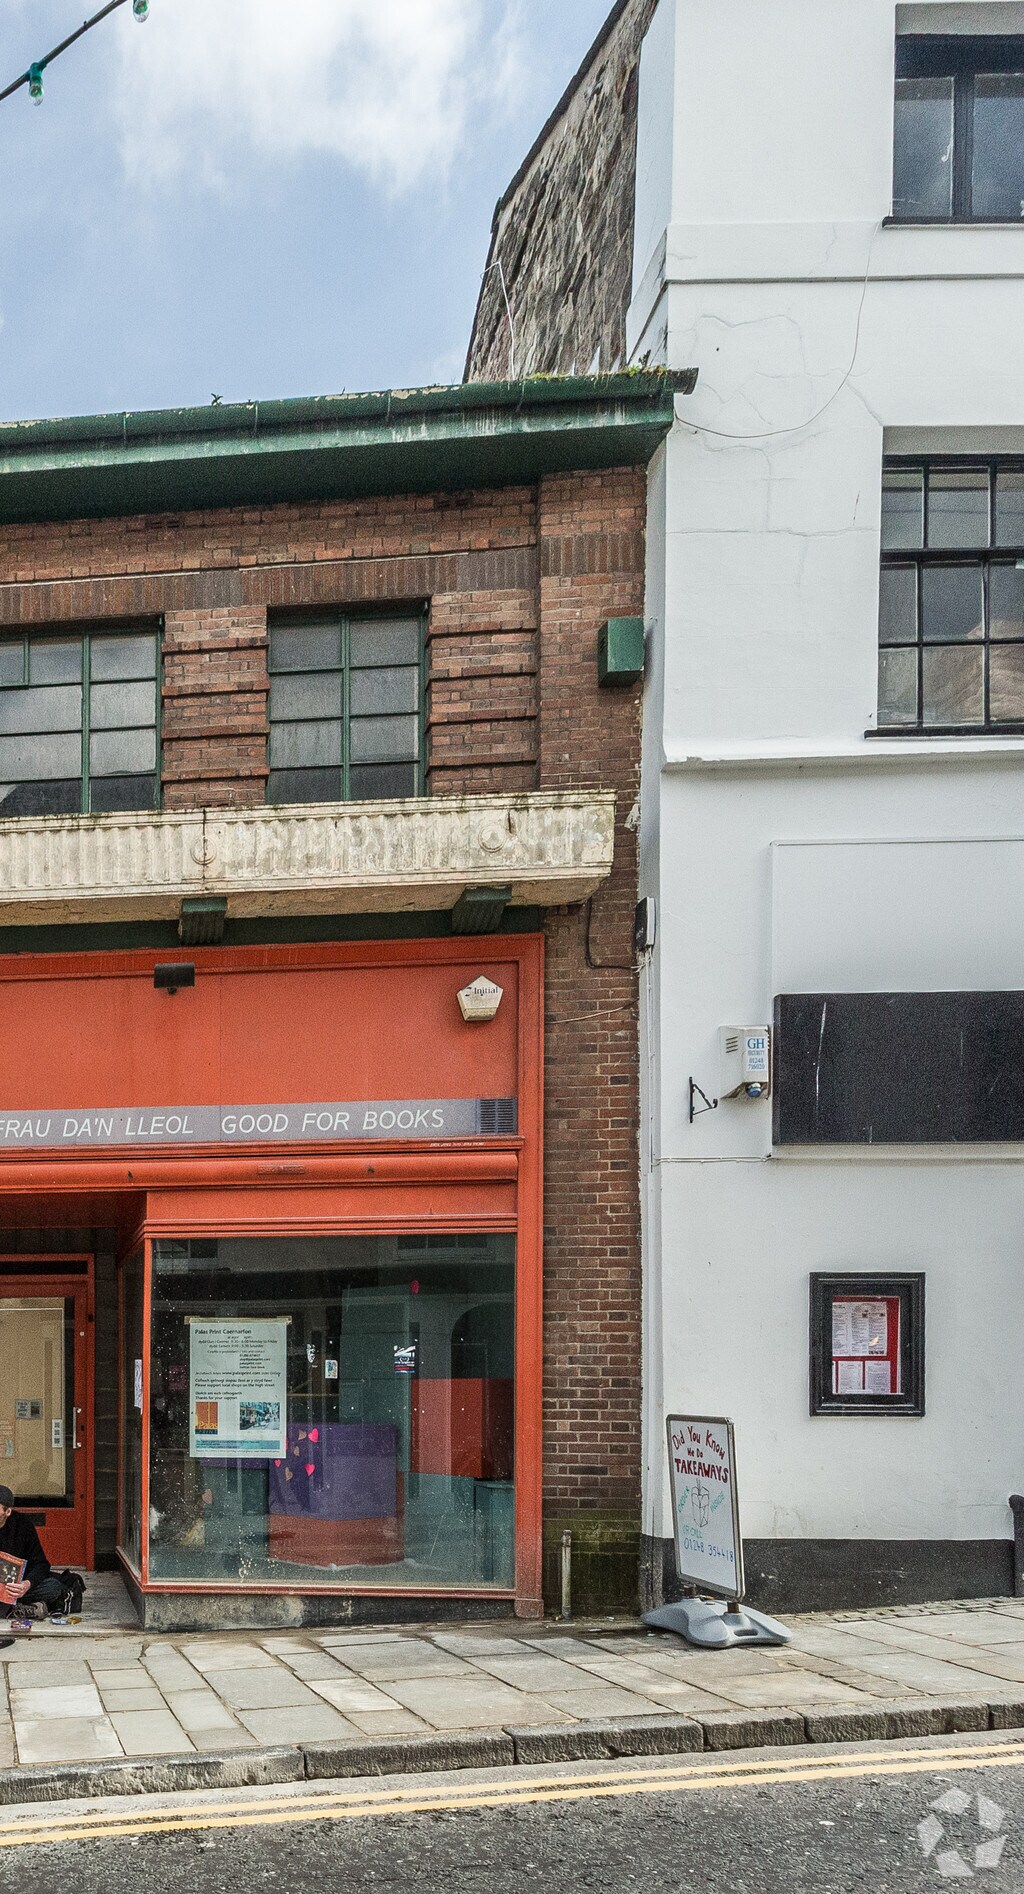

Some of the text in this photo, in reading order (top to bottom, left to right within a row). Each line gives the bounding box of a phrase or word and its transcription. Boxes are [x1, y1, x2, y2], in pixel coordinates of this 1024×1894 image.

[474, 987, 498, 995] Initial
[747, 1038, 765, 1049] GH
[62, 1117, 113, 1137] DA'N
[125, 1115, 194, 1136] LLEOL
[221, 1109, 445, 1134] GOOD FOR BOOKS
[672, 1425, 725, 1460] Did You Know
[687, 1447, 704, 1458] We Do
[675, 1458, 729, 1483] TAKEAWAYS
